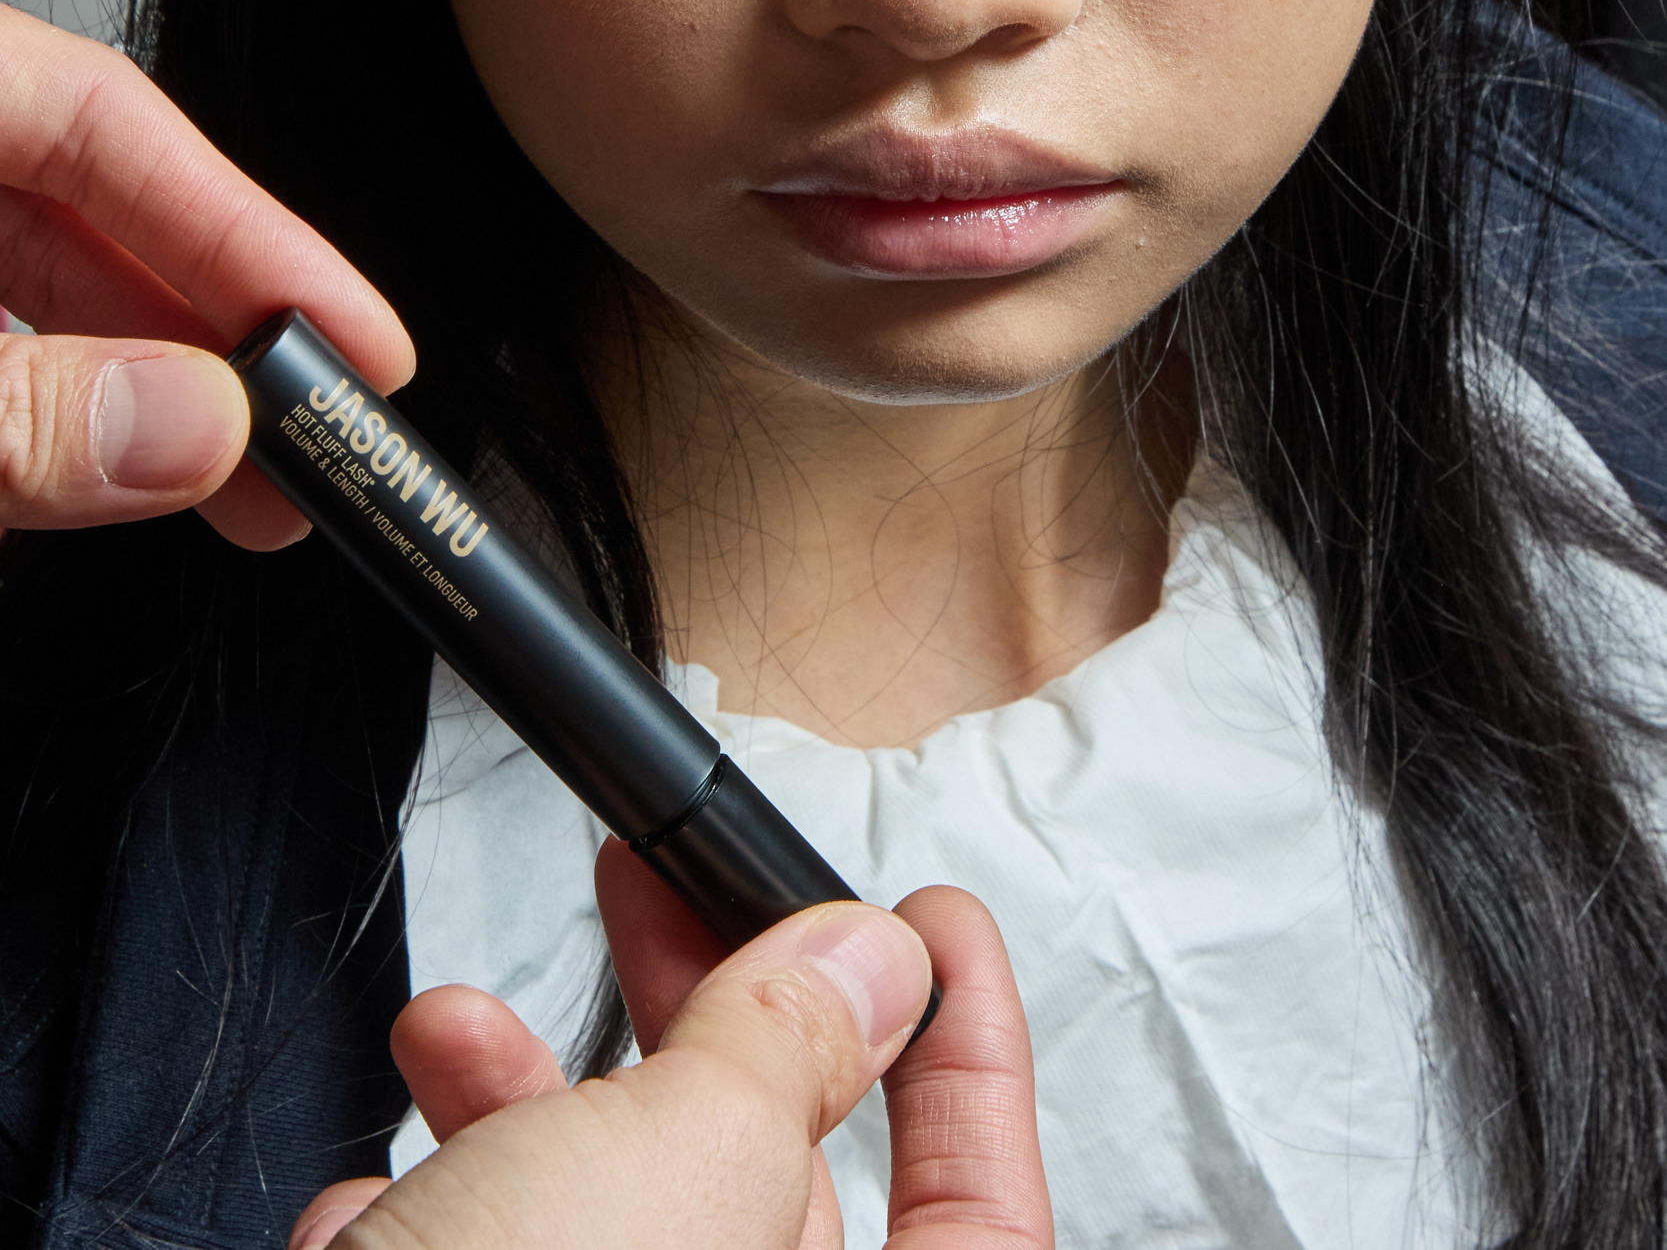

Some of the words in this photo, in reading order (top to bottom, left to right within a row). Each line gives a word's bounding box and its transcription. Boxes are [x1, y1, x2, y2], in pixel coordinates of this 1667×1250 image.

[280, 416, 323, 462] VOLUME
[318, 457, 328, 469] &
[327, 468, 370, 510] LENGTH
[364, 506, 376, 514] /
[372, 511, 415, 556] VOLUME
[410, 550, 428, 568] ET
[423, 564, 478, 621] LONGUEUR
[291, 404, 316, 429] HOT
[311, 423, 346, 460] FLUFF
[309, 378, 432, 502] JASON
[420, 479, 489, 557] WU
